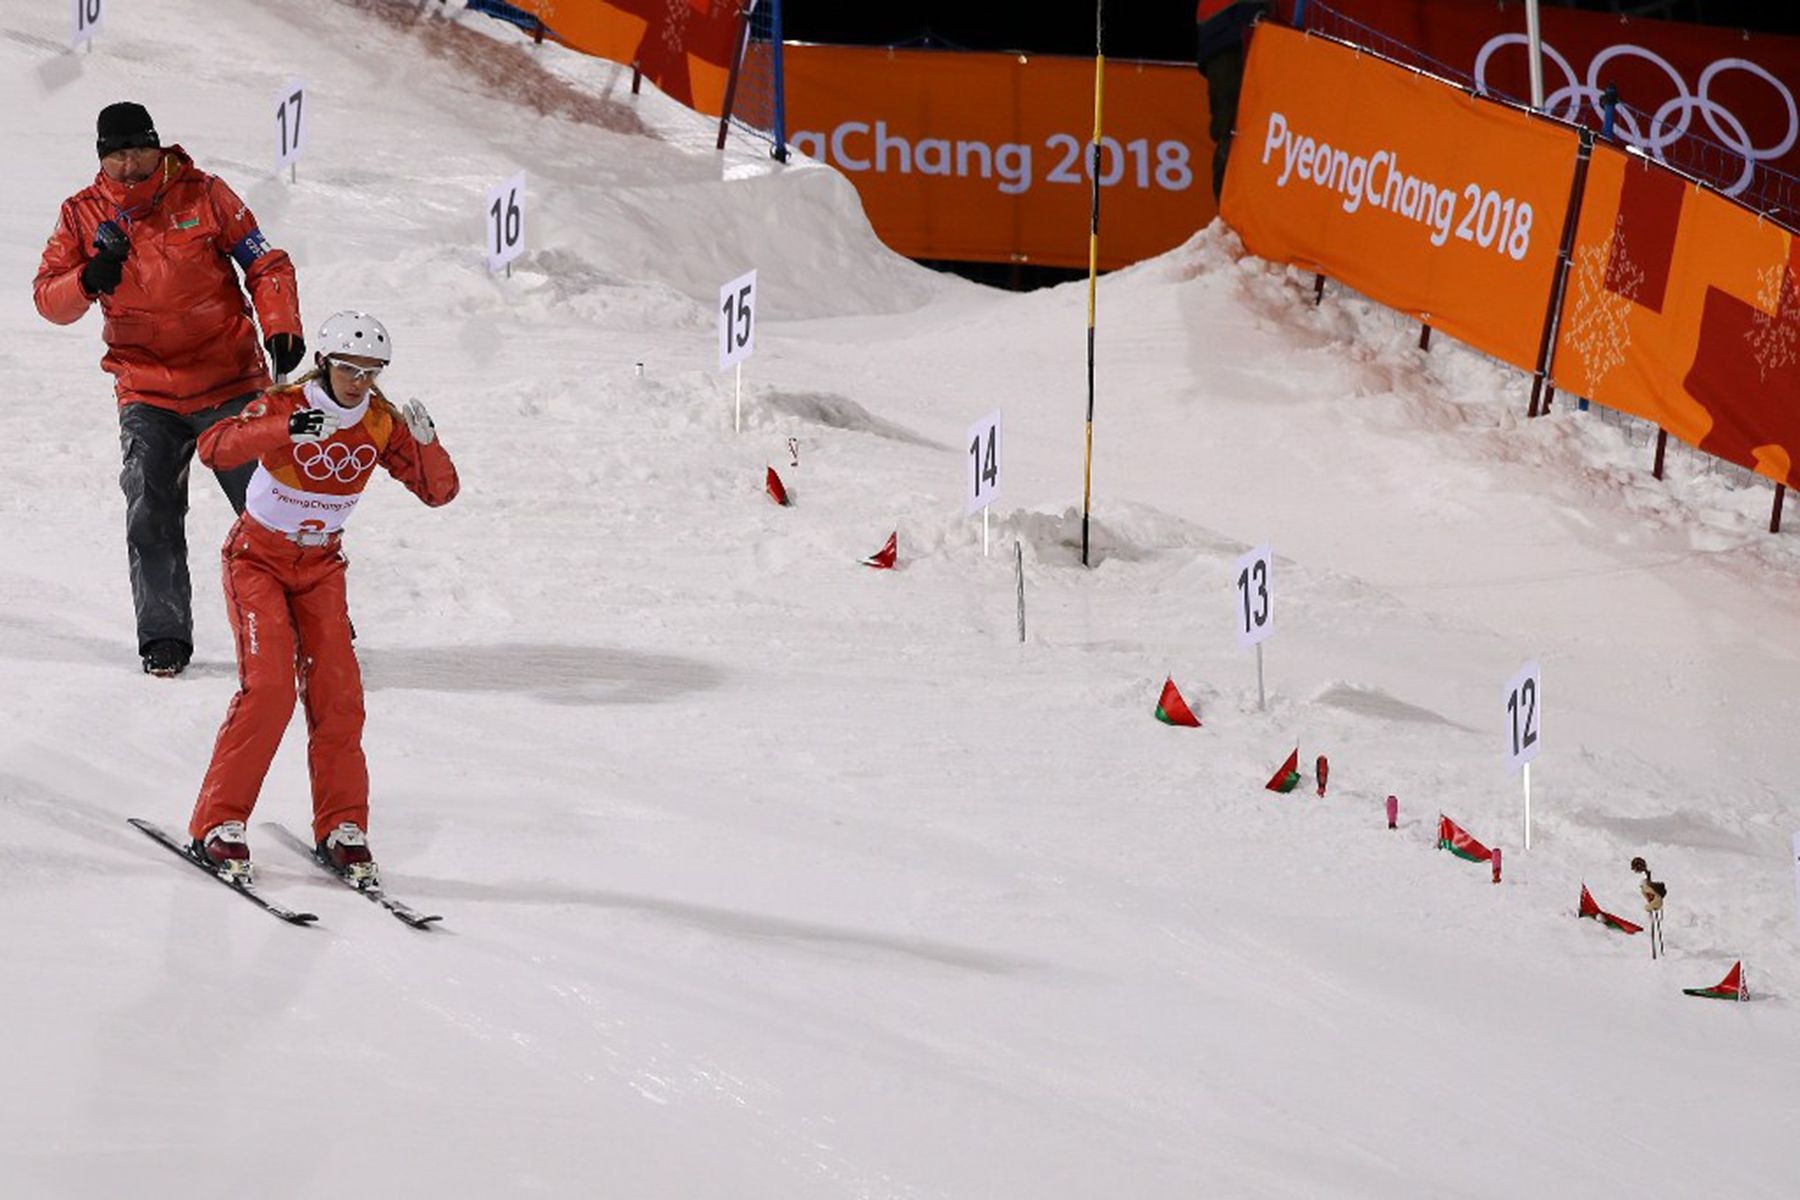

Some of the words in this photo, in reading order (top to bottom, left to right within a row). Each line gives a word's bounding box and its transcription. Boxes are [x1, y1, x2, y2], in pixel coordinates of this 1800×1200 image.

[277, 89, 303, 156] 17
[1046, 133, 1193, 191] 2018
[1262, 112, 1457, 247] PyeongChang
[1455, 183, 1534, 261] 2018
[490, 188, 520, 254] 16
[722, 284, 751, 354] 15
[970, 424, 997, 497] 14
[1237, 559, 1268, 633] 13
[1507, 677, 1537, 756] 12
